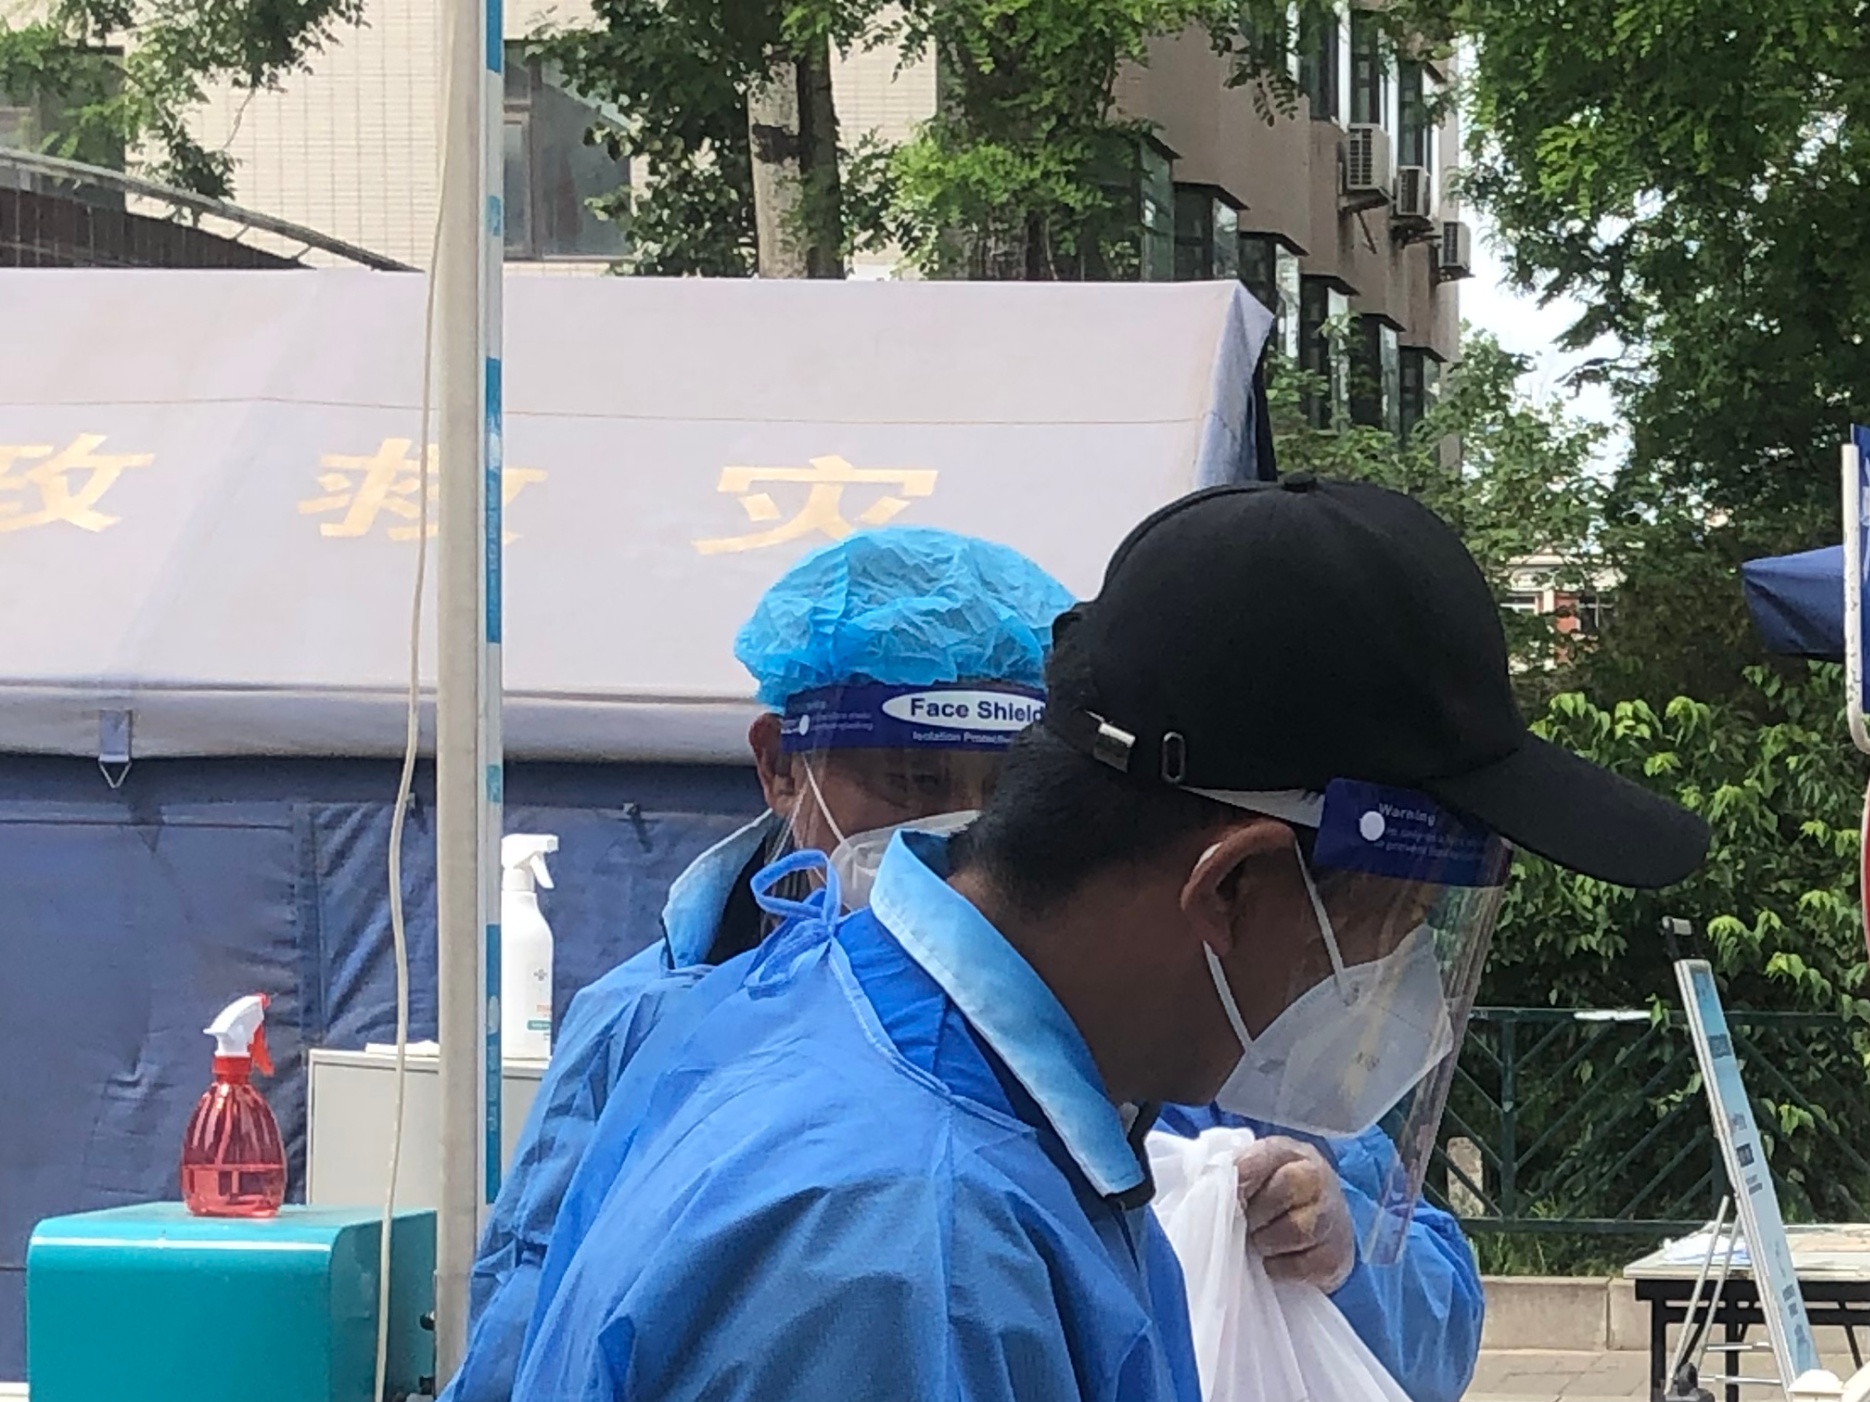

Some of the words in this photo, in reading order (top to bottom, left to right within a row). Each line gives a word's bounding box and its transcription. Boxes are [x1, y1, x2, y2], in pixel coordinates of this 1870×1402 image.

[909, 697, 970, 719] Face
[976, 700, 1046, 723] Shield
[1378, 802, 1437, 827] Warning
